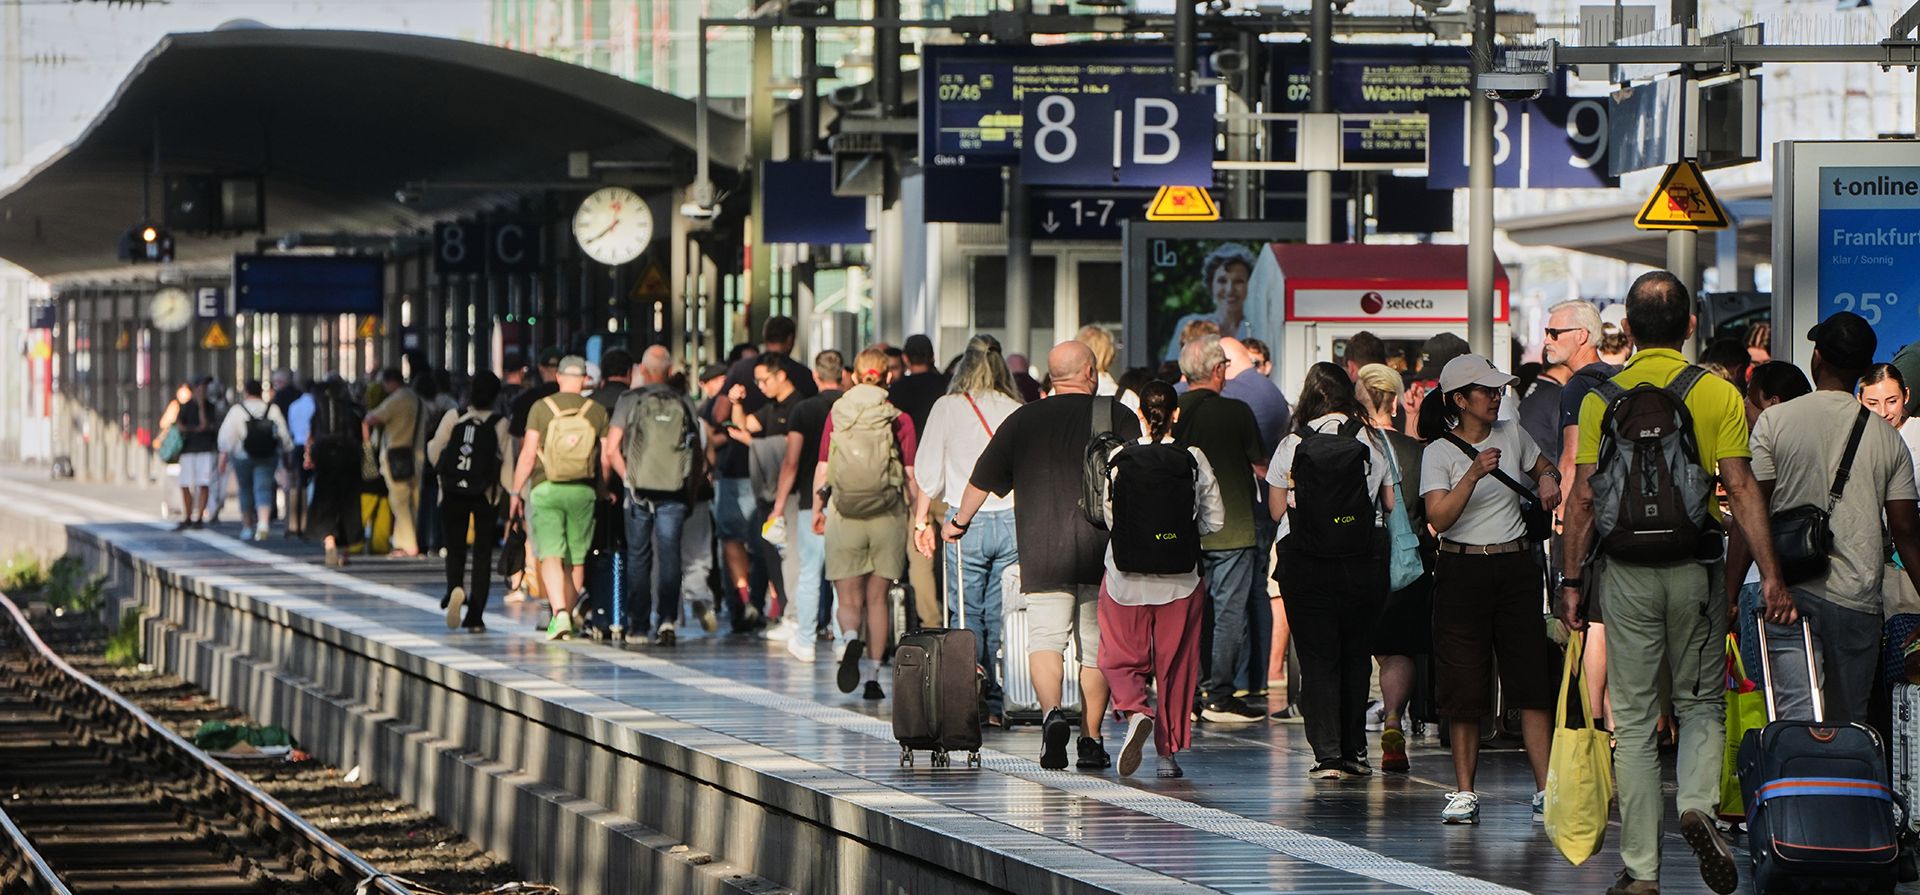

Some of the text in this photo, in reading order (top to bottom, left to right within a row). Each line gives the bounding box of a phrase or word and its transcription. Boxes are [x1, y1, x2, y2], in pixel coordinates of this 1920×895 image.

[1034, 95, 1181, 164] 8 B
[1566, 100, 1609, 168] 9
[1832, 176, 1919, 196] t-online
[1070, 199, 1115, 227] 1-7
[441, 224, 524, 263] 8 C
[1832, 255, 1851, 265] Klar
[1860, 255, 1894, 266] Sonnig
[198, 287, 217, 317] E
[1386, 298, 1434, 310] selecta
